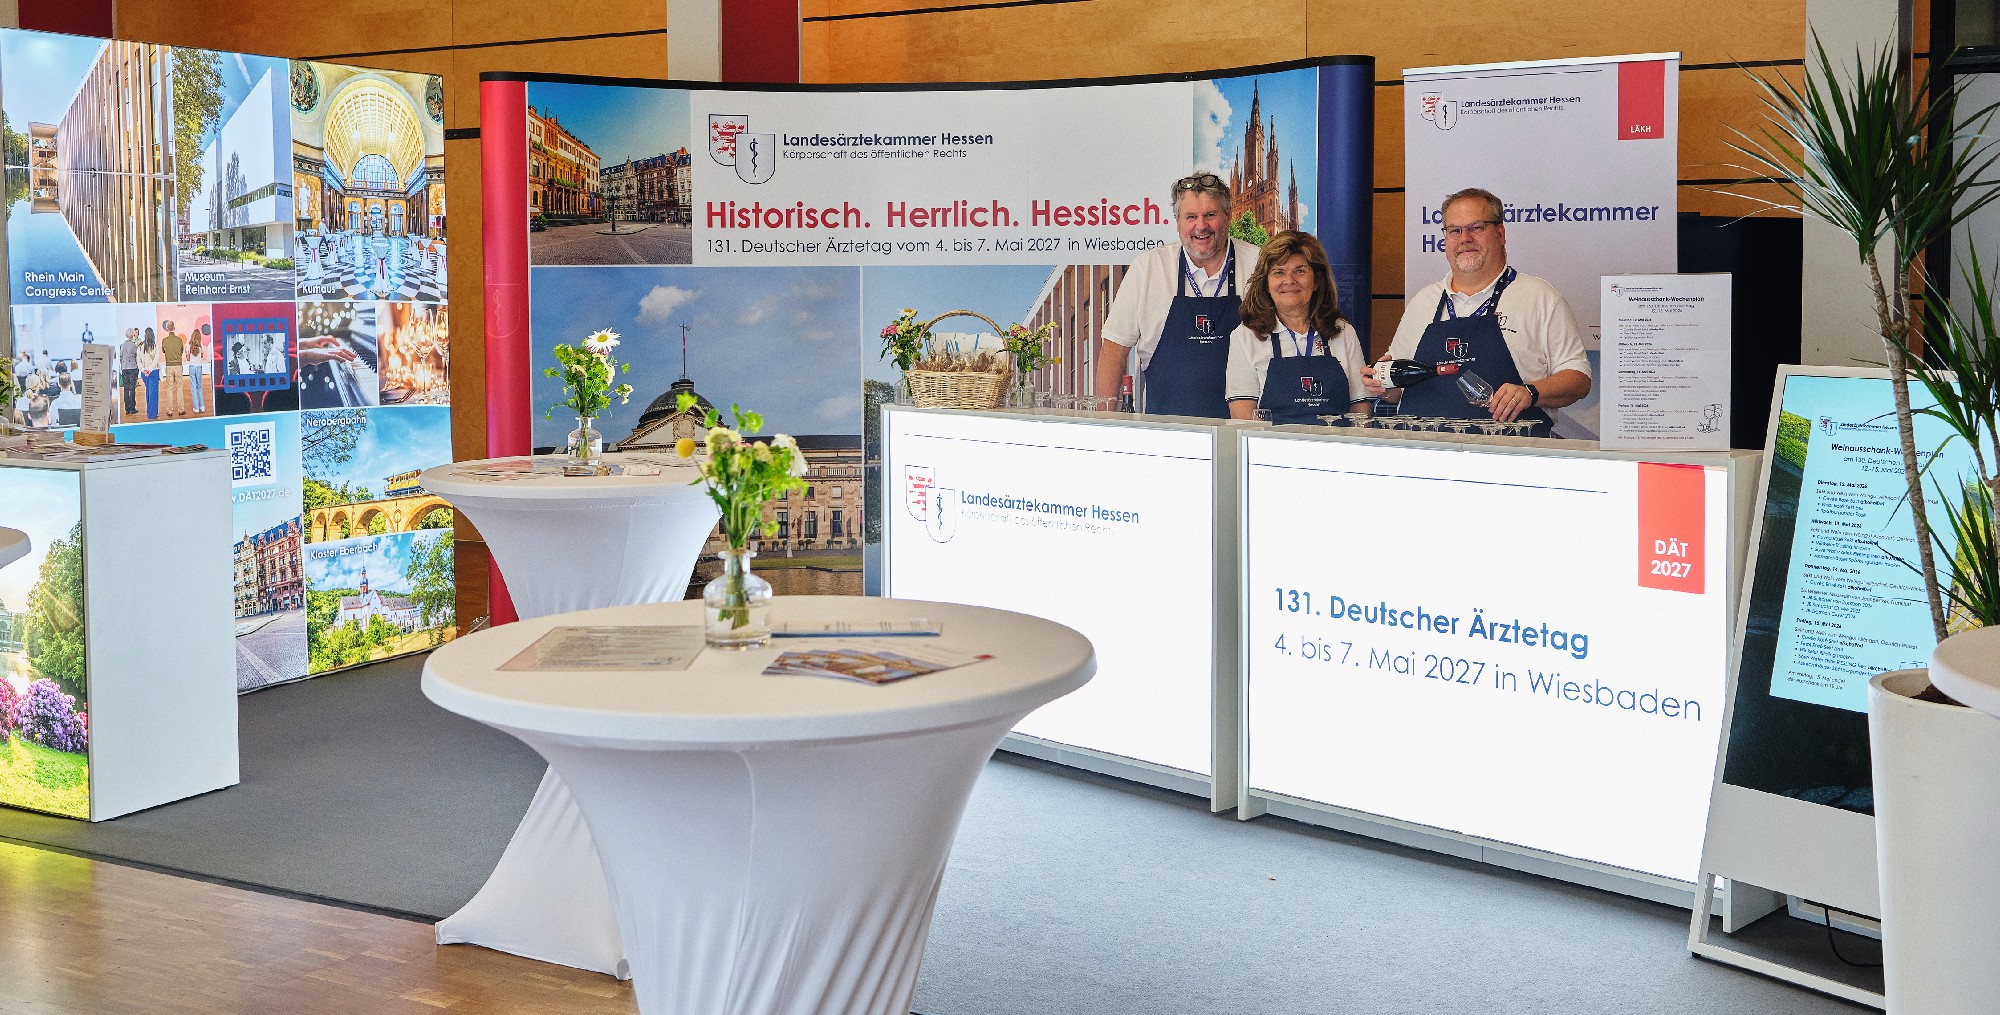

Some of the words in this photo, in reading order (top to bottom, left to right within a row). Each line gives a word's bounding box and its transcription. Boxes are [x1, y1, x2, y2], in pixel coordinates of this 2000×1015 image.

[1461, 97, 1547, 107] Landesärztekammer
[1630, 124, 1652, 134] LÄKH
[783, 134, 936, 146] Landesärztekammer
[942, 133, 993, 145] Hessen
[934, 149, 966, 158] Rechts
[707, 201, 870, 230] Historisch.
[887, 199, 1019, 228] Herrlich.
[1032, 197, 1169, 226] Hessisch.
[1422, 203, 1660, 224] Laärztekammer
[707, 239, 736, 253] 131.
[742, 238, 822, 253] Deutscher
[826, 236, 892, 255] Ärztetag
[896, 241, 930, 252] vom
[936, 238, 948, 252] 4.
[953, 238, 974, 252] bis
[978, 238, 990, 252] 7.
[995, 238, 1022, 252] Mai
[1027, 238, 1060, 252] 2027
[1068, 238, 1080, 250] in
[1084, 237, 1164, 250] Wiesbaden
[24, 272, 55, 282] Rhein
[58, 272, 84, 282] Main
[185, 272, 225, 282] Museum
[25, 286, 76, 298] Congress
[80, 286, 115, 296] Center
[186, 284, 226, 294] Reinhard
[230, 284, 250, 294] Ernst
[302, 284, 336, 294] Kurhaus
[306, 416, 367, 428] Nerobergbahn
[962, 491, 1088, 518] Landesärztekammer
[1092, 504, 1139, 523] Hessen
[310, 550, 337, 560] Kloster
[340, 542, 378, 556] Eberbach
[1655, 537, 1688, 558] DÄT
[1651, 560, 1691, 579] 2027
[1276, 588, 1320, 615] 131.
[1330, 595, 1459, 635] Deutscher
[1469, 608, 1589, 660] Ärztetag
[1274, 633, 1292, 656] 4.
[1301, 635, 1332, 663] bis
[1340, 641, 1360, 667] 7.
[1369, 648, 1416, 676] Mai
[1424, 654, 1486, 685] 2027
[1495, 664, 1516, 692] in
[1528, 668, 1701, 721] Wiesbaden
